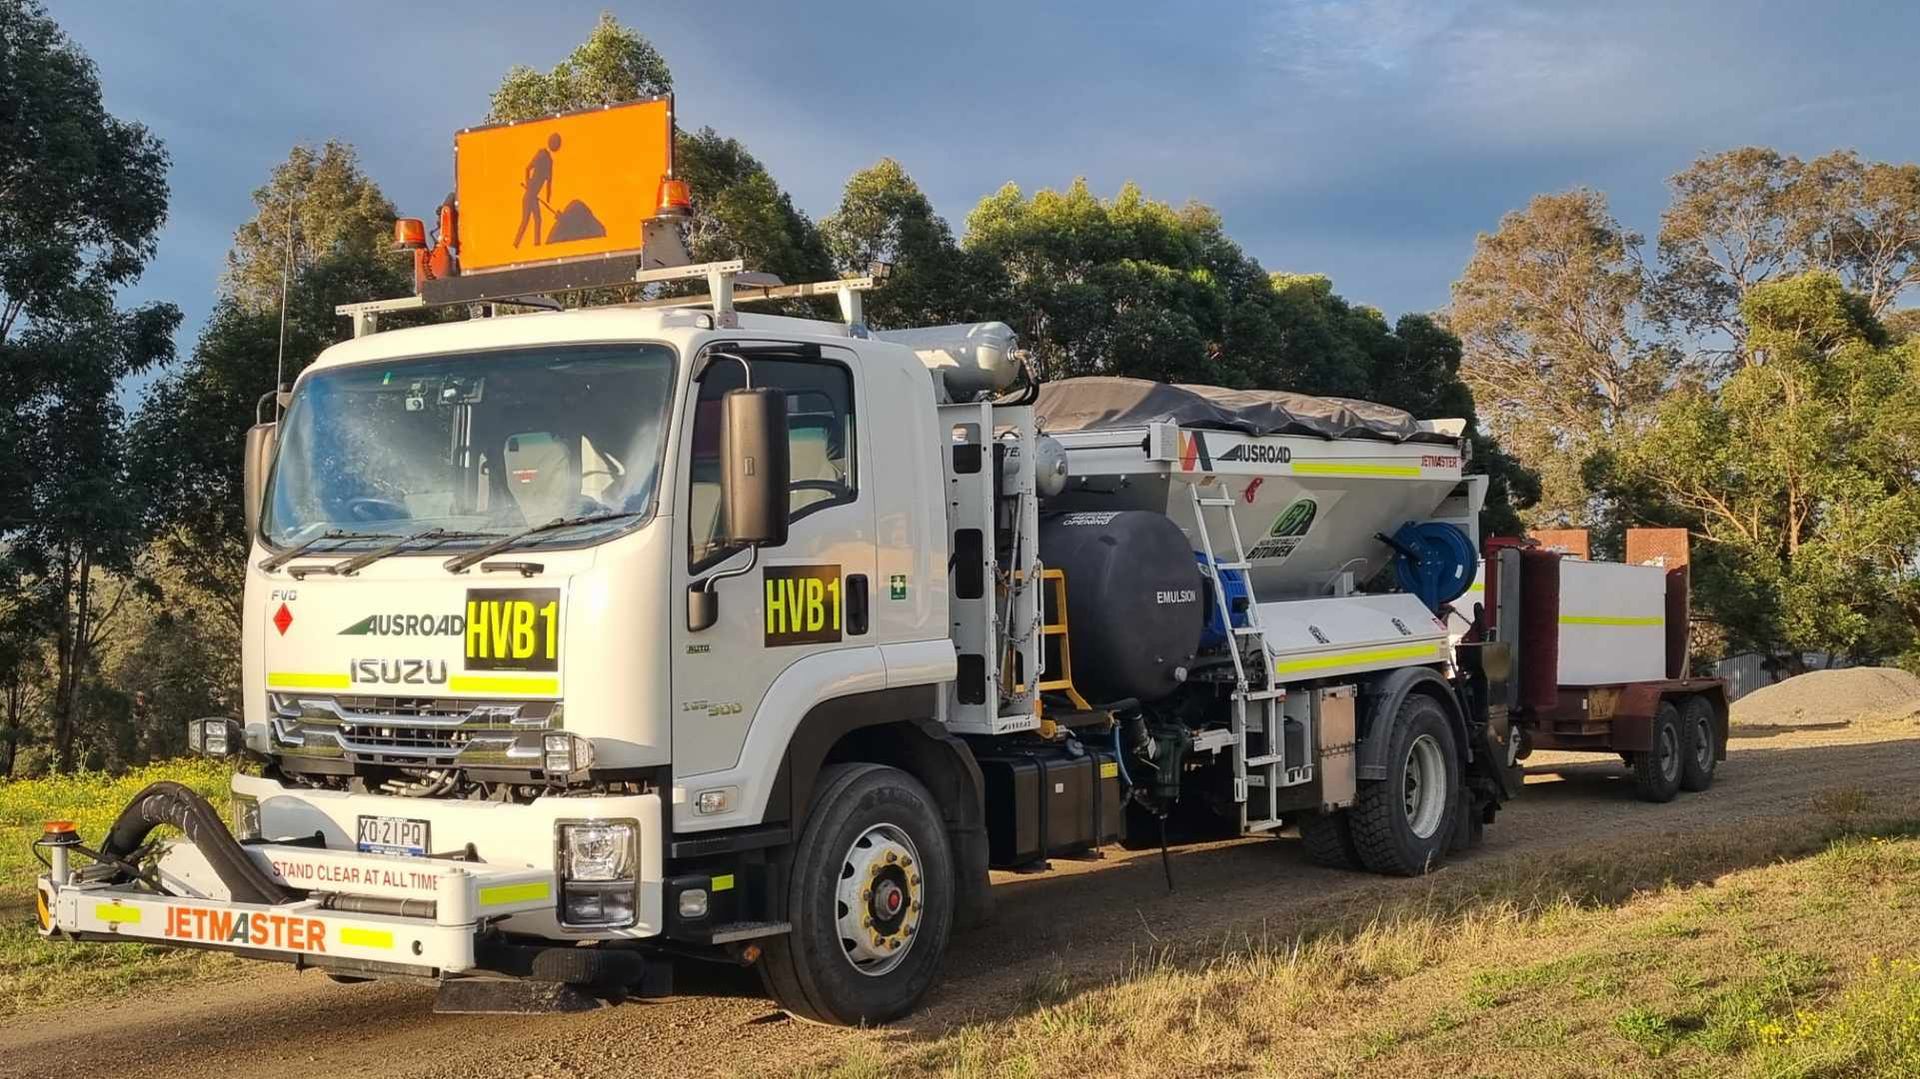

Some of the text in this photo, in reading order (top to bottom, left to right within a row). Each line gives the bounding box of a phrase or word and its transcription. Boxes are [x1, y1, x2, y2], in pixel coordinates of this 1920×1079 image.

[1217, 444, 1291, 463] AUSROAD
[1421, 455, 1457, 468] JETMASTER
[1246, 545, 1296, 560] BITUMEN
[1157, 590, 1196, 604] EMULSION
[337, 614, 465, 637] AUSROAD
[687, 644, 710, 654] AUTO
[350, 658, 448, 685] ISUZU
[272, 861, 313, 879] STAND
[317, 865, 360, 883] CLEAR
[364, 870, 380, 885] AT
[383, 871, 408, 888] ALL
[164, 906, 327, 952] JETMASTER
